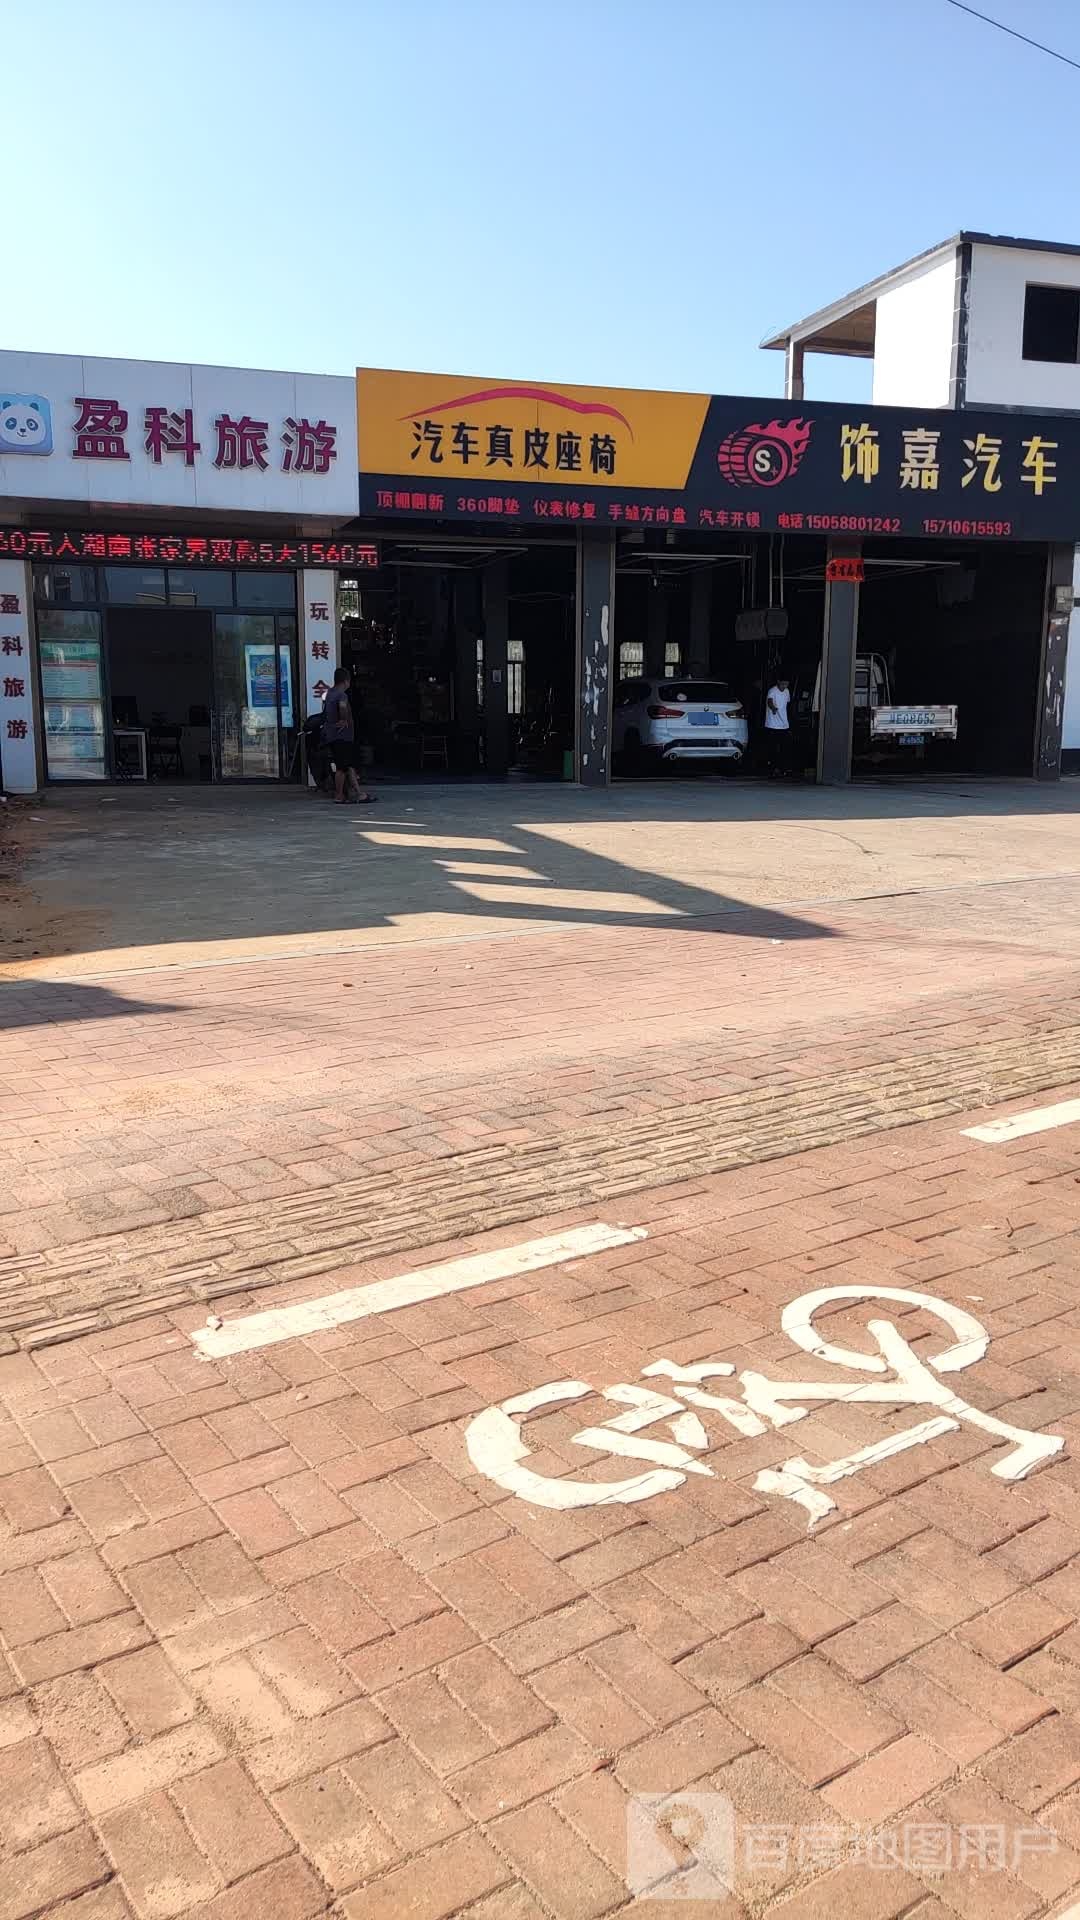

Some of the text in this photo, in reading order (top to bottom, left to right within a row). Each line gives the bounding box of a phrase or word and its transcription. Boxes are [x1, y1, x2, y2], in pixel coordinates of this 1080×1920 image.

[73, 397, 338, 474] 盈科旅游
[410, 419, 617, 475] 汽车真皮座椅
[840, 423, 1058, 495] 饰嘉汽车
[457, 497, 520, 515] 360脚垫
[534, 500, 597, 519] 仪表修复
[608, 504, 686, 524] 手缝方向盘
[699, 509, 760, 529] 汽车开锁
[923, 518, 1011, 536] 15710615593
[0, 593, 28, 739] 盈科旅游
